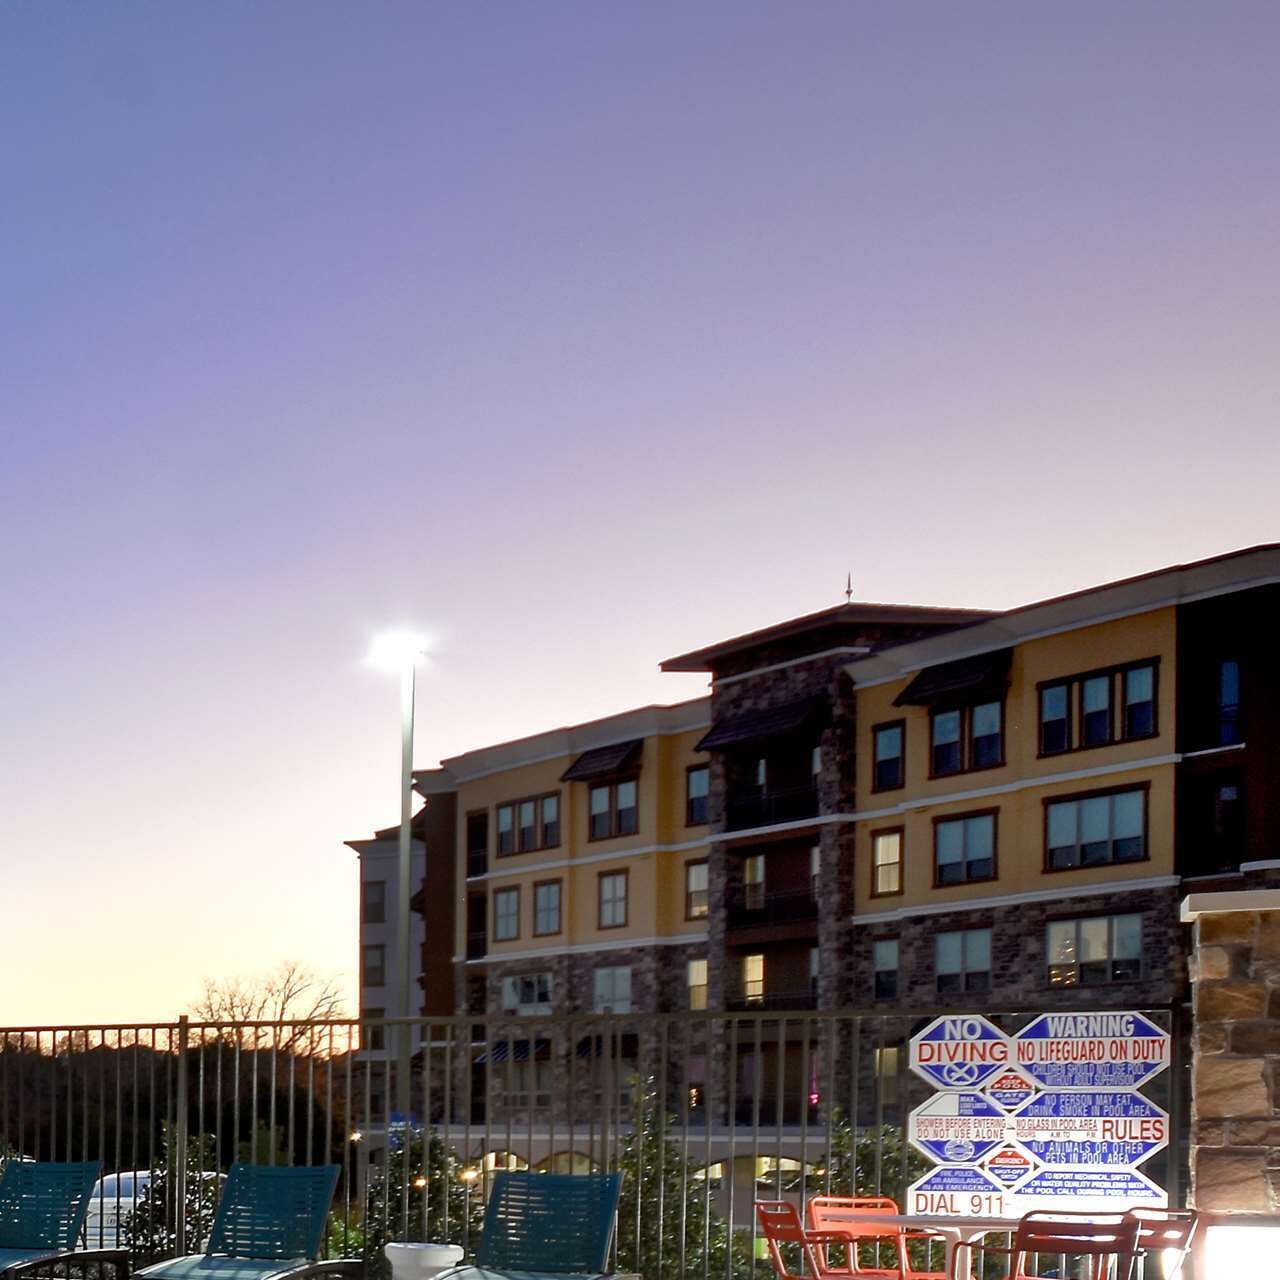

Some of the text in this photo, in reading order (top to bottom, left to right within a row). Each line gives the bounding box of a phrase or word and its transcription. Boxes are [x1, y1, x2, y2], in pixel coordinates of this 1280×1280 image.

[944, 1019, 982, 1040] NO
[1047, 1014, 1135, 1038] WARNING
[918, 1041, 1008, 1063] DIVING
[1017, 1039, 1166, 1061] NO LIFEGUARD ON DUTY
[1067, 1064, 1094, 1075] SHOULD
[1096, 1064, 1111, 1075] NOT
[1113, 1064, 1126, 1074] USE
[1045, 1095, 1056, 1105] NO
[1060, 1095, 1091, 1105] PERSON
[1096, 1095, 1113, 1105] MAY
[1060, 1105, 1088, 1116] SMOKE
[1092, 1105, 1101, 1116] IN
[1104, 1105, 1126, 1116] POOL
[1129, 1106, 1151, 1117] AREA
[916, 1119, 1007, 1129] SHOWER BEFORE ENTERING
[1016, 1119, 1098, 1129] NO GLASS IN POOL AREA
[1102, 1119, 1164, 1140] RULES
[917, 1129, 1004, 1139] DO NOT USE ALONE
[1032, 1142, 1144, 1154] NO ANIMALS OR OTHER
[1045, 1153, 1130, 1165] PETS IN POOL AREA
[916, 1193, 1003, 1214] DIAL 911
